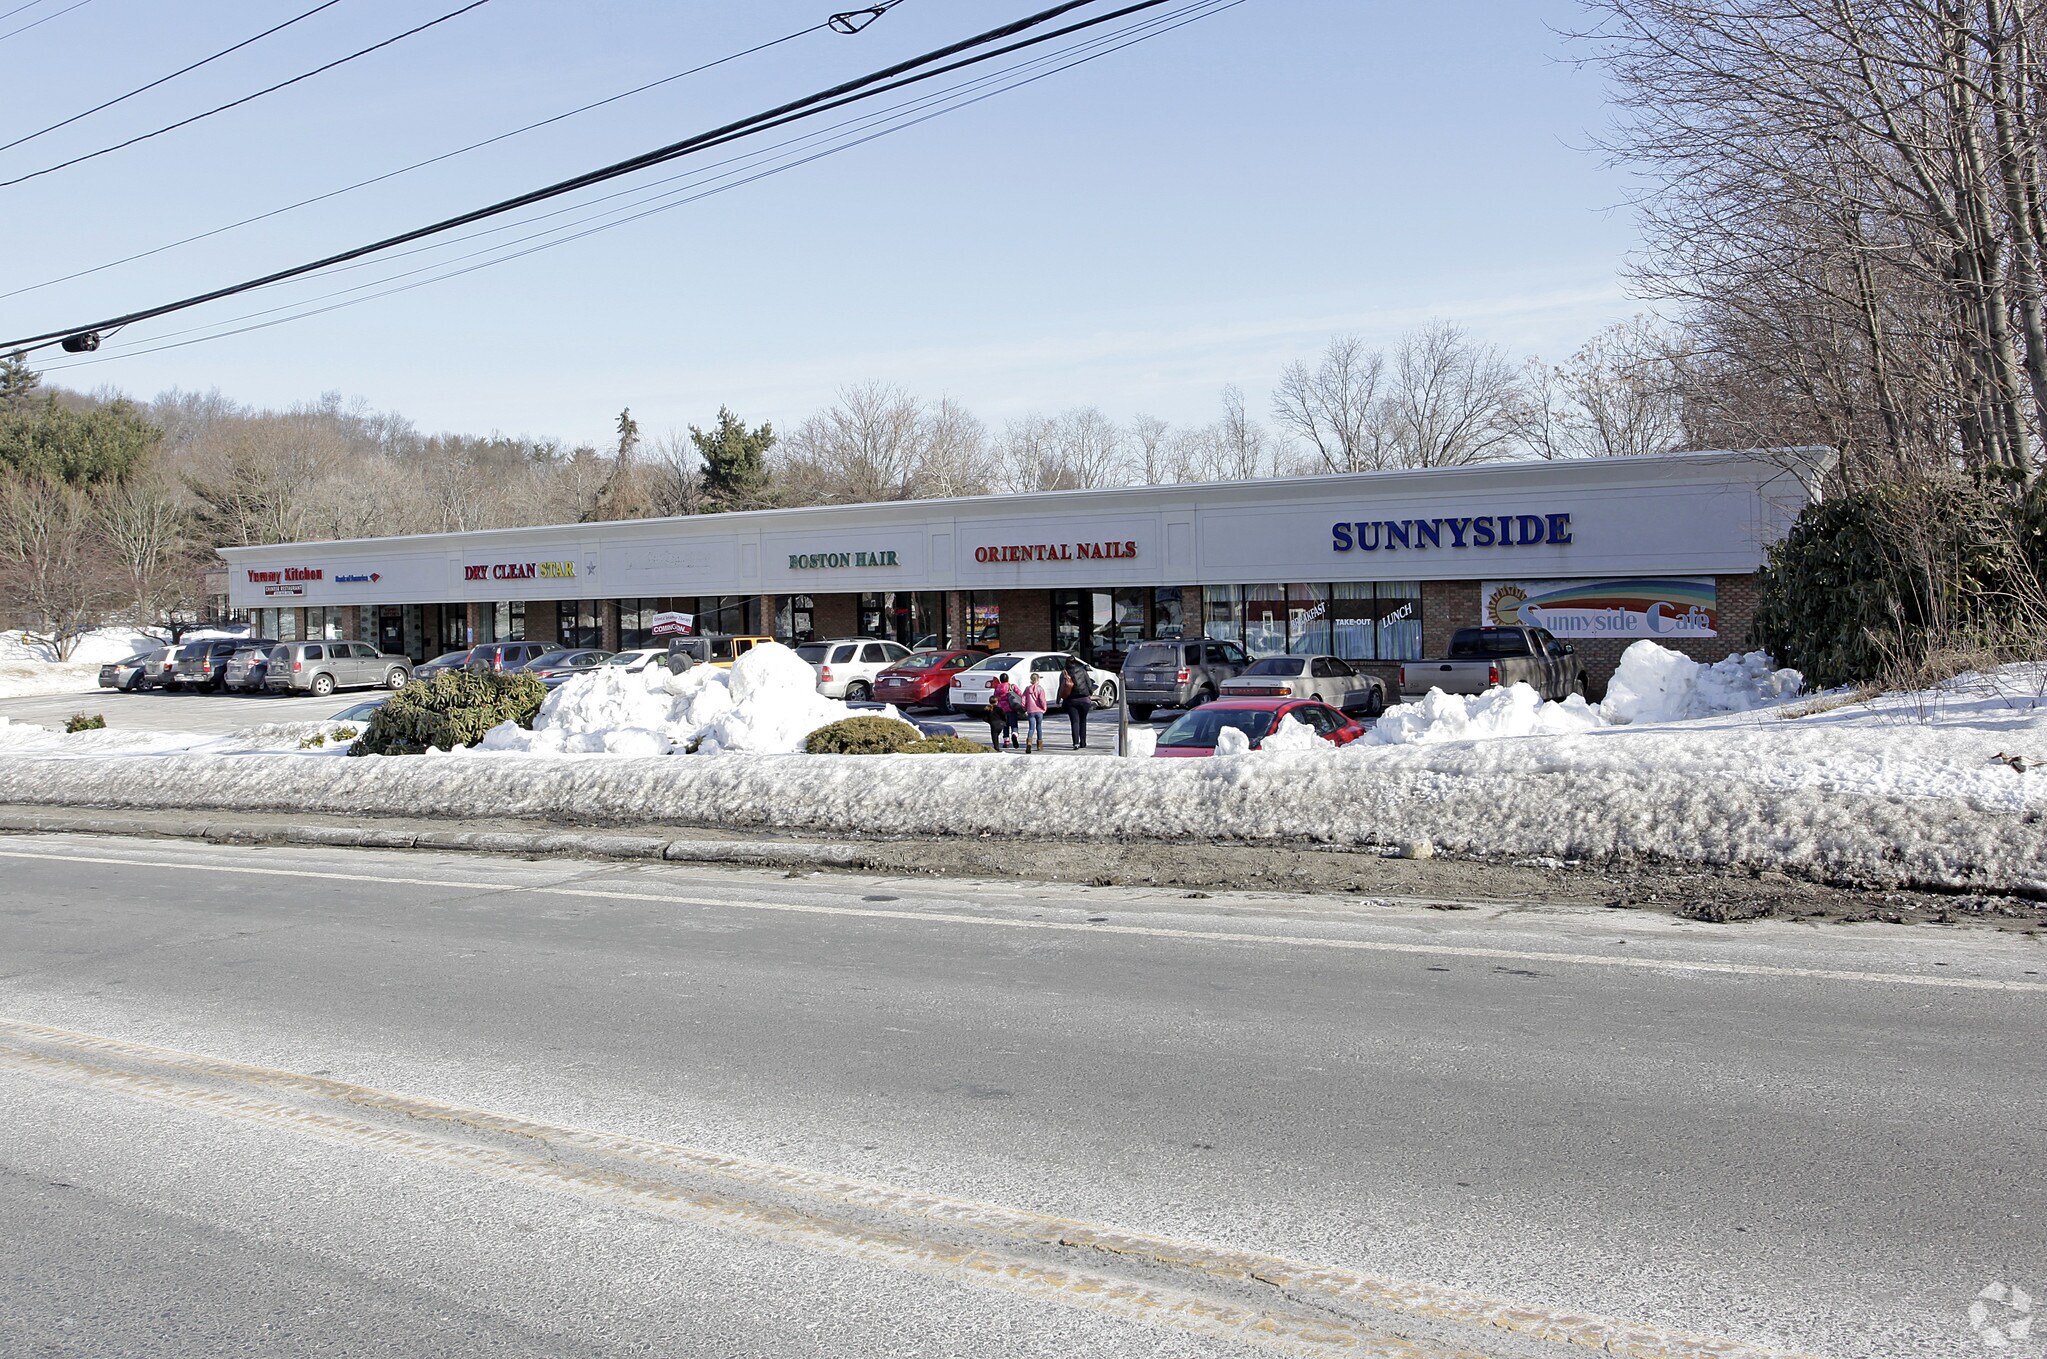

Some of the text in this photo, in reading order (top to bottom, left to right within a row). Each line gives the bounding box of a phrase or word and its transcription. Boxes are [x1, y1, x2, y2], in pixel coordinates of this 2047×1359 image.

[1332, 513, 1573, 551] SUNNYSIDE
[788, 550, 901, 569] BOSTON HAIR
[974, 541, 1137, 563] ORIENTAL NAILS
[247, 566, 323, 584] Yummy Kitchen
[464, 561, 576, 580] DRY CLEAN STAR
[1290, 602, 1326, 628] BREAKFAST
[1335, 618, 1372, 626] TAKE-OUT
[1381, 602, 1413, 629] LUNCH
[1516, 601, 1710, 634] Sunnyside Café
